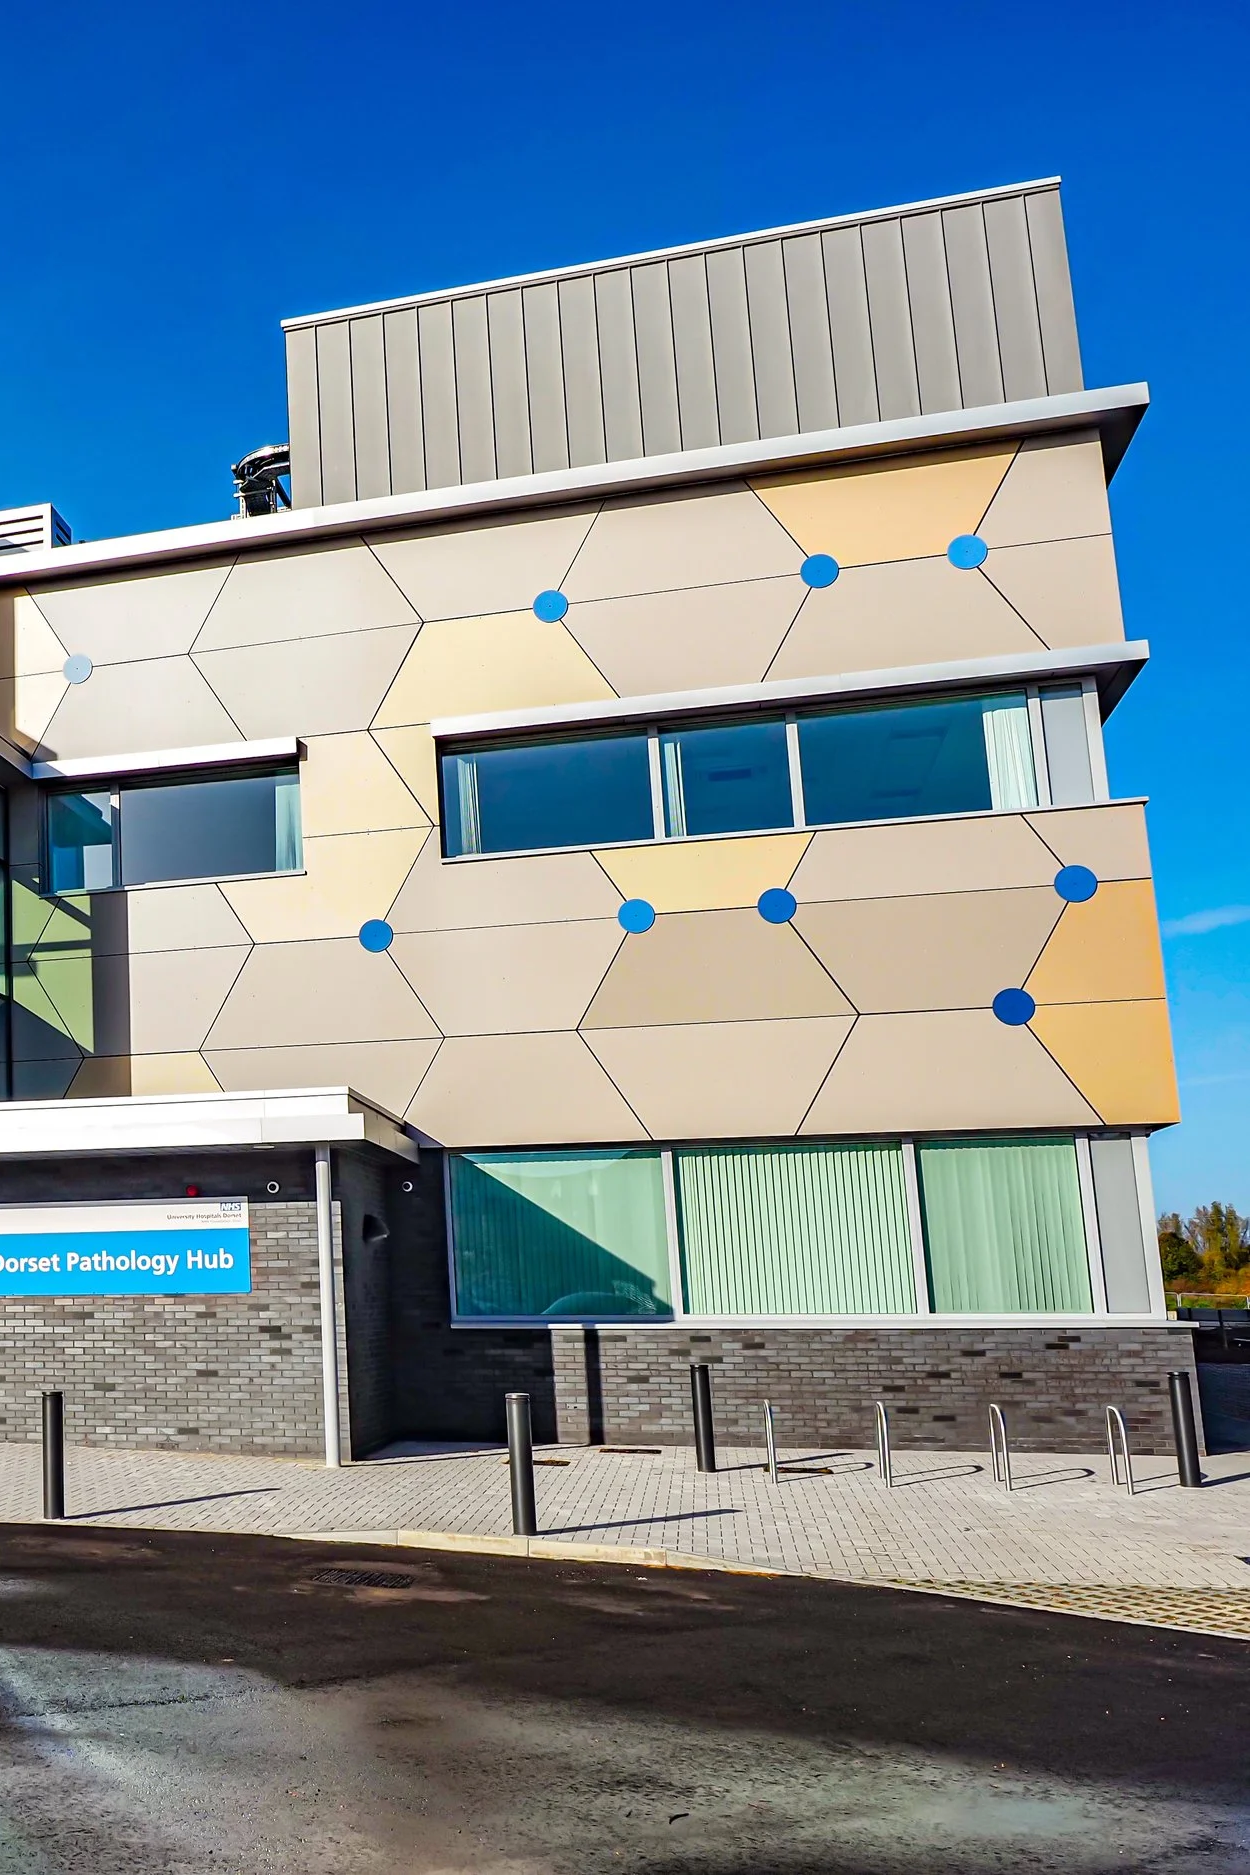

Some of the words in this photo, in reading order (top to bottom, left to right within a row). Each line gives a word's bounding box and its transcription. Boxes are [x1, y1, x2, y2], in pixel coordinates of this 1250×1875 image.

[221, 1203, 241, 1211] NHS
[196, 1212, 221, 1220] Hospitals
[66, 1250, 179, 1276] Pathology
[187, 1248, 234, 1269] Hub
